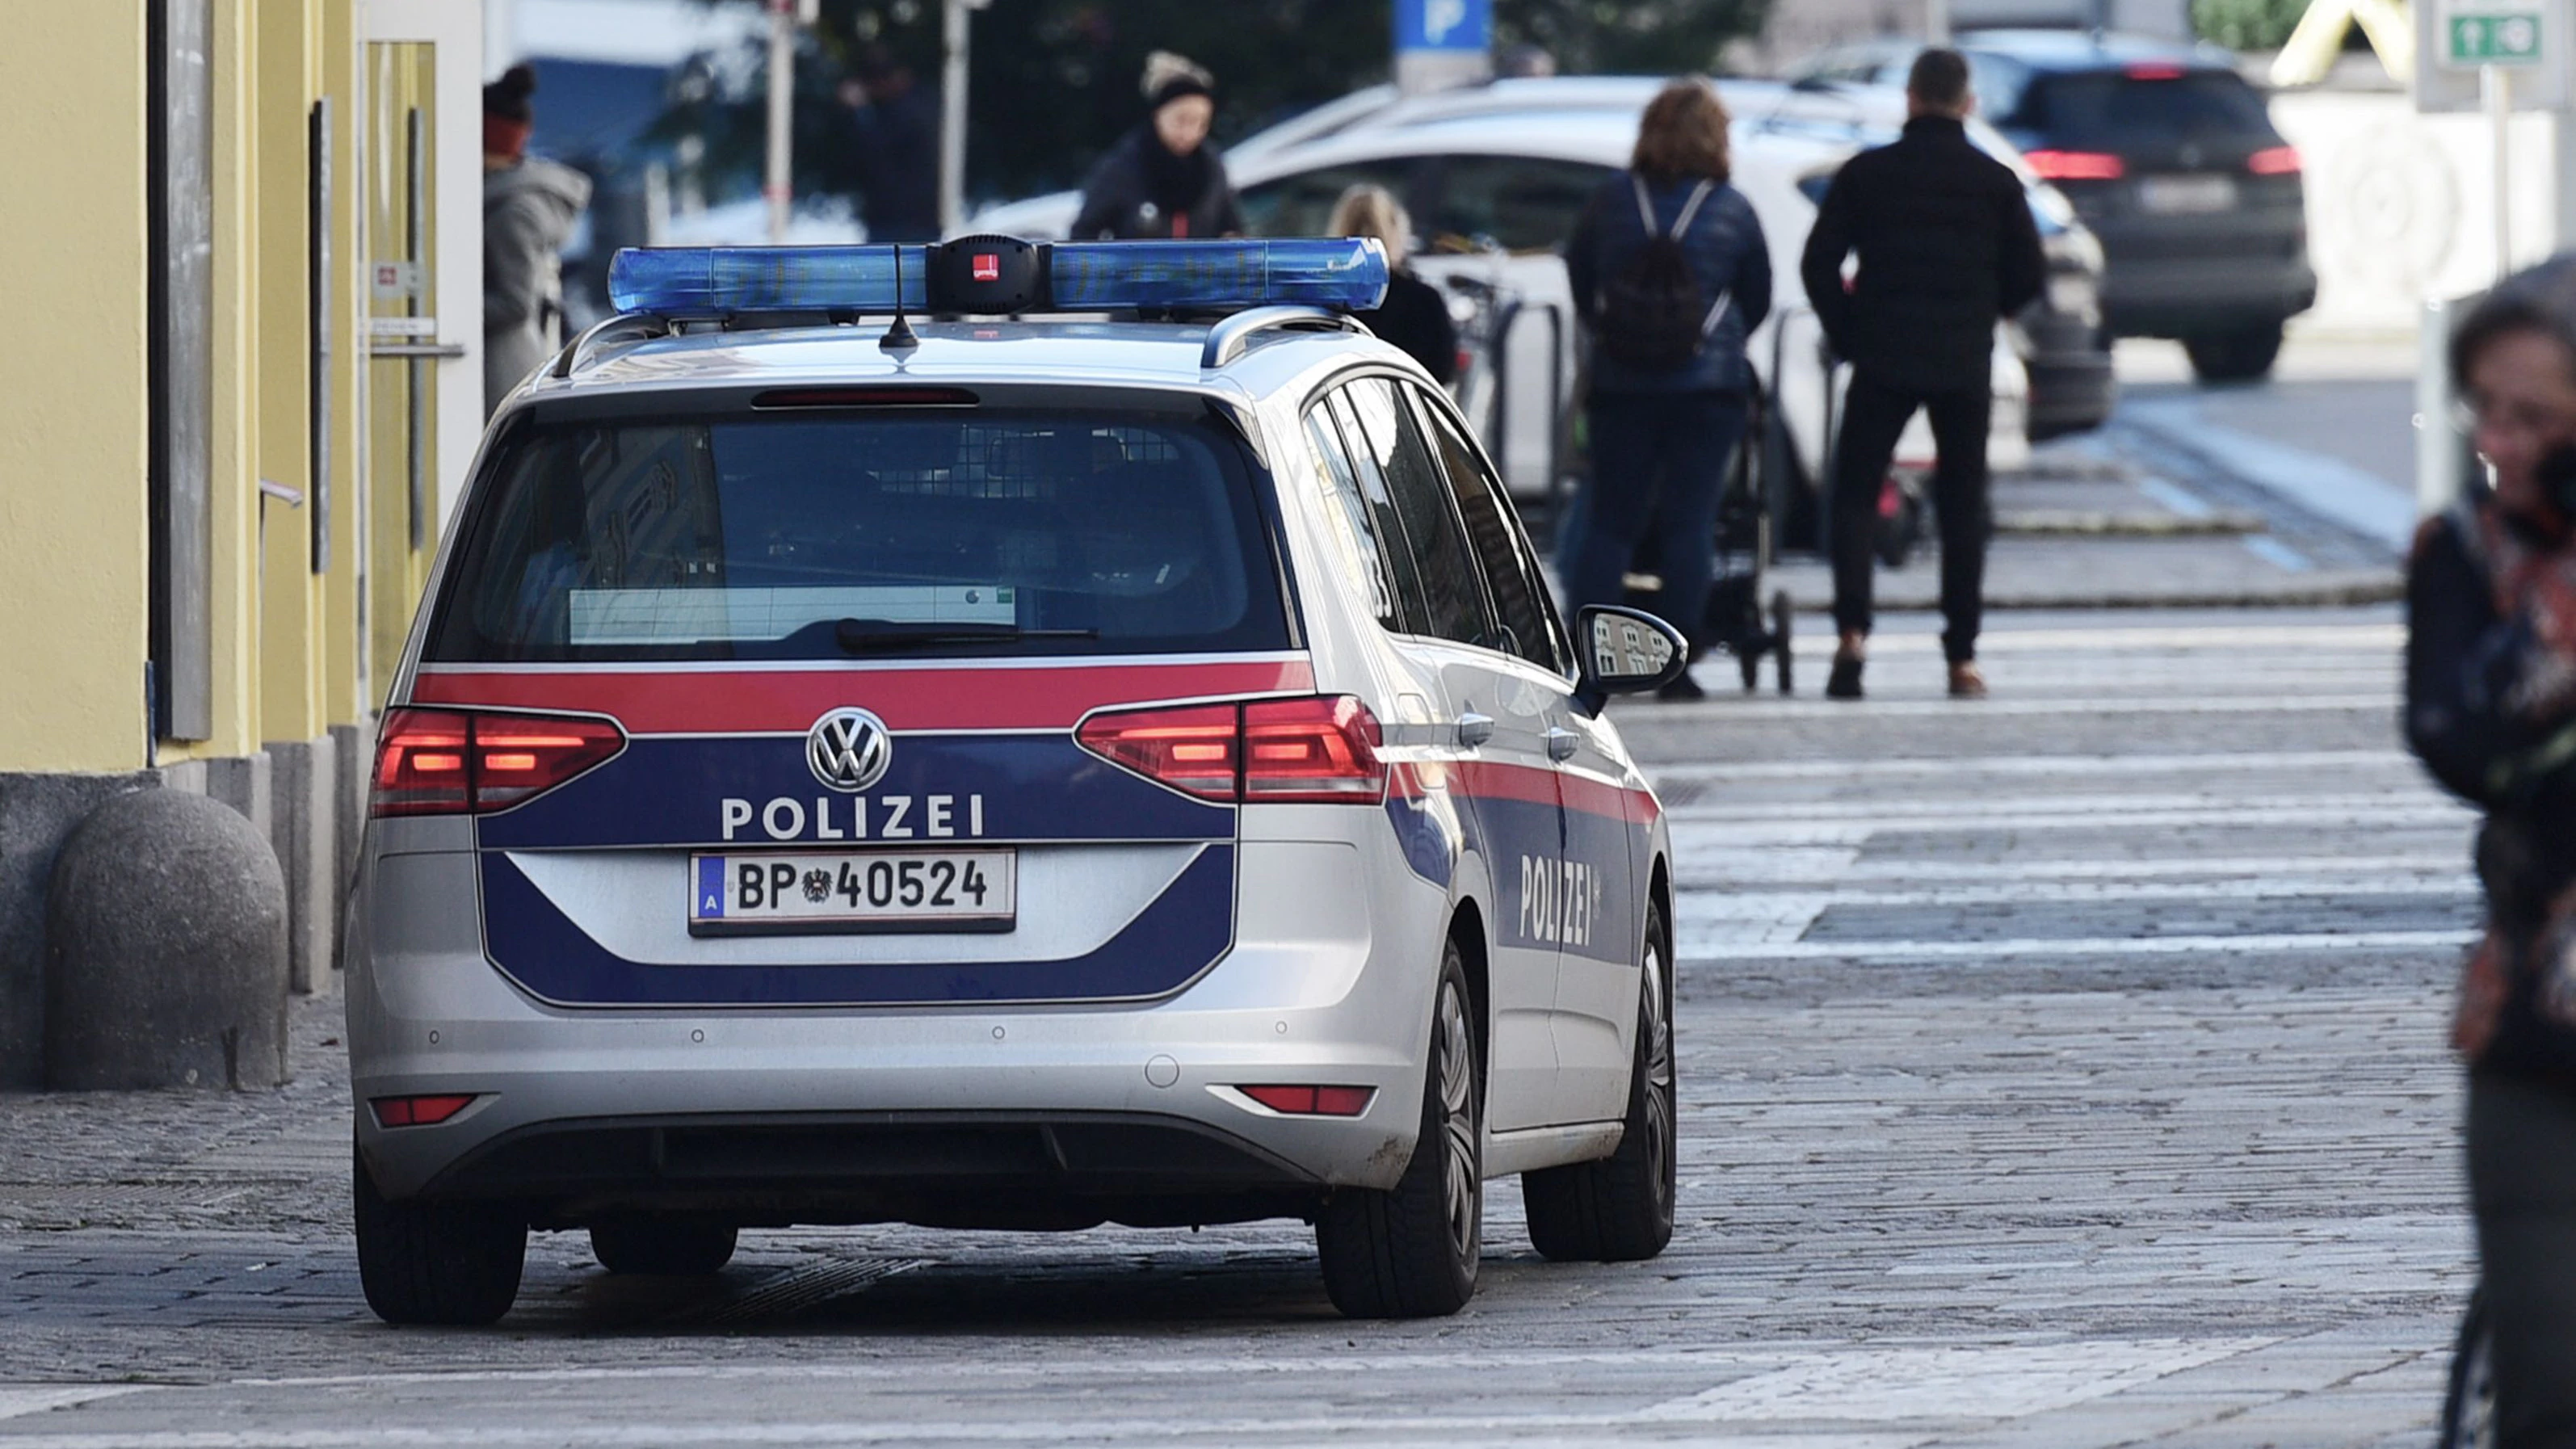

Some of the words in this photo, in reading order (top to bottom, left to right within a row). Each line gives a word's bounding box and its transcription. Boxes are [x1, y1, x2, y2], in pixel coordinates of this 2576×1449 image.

[1422, 0, 1467, 45] P
[721, 794, 983, 840] POLIZEI
[704, 894, 718, 910] A
[738, 863, 796, 909] BP
[836, 859, 987, 908] 40524
[1519, 854, 1591, 947] POLIZEI
